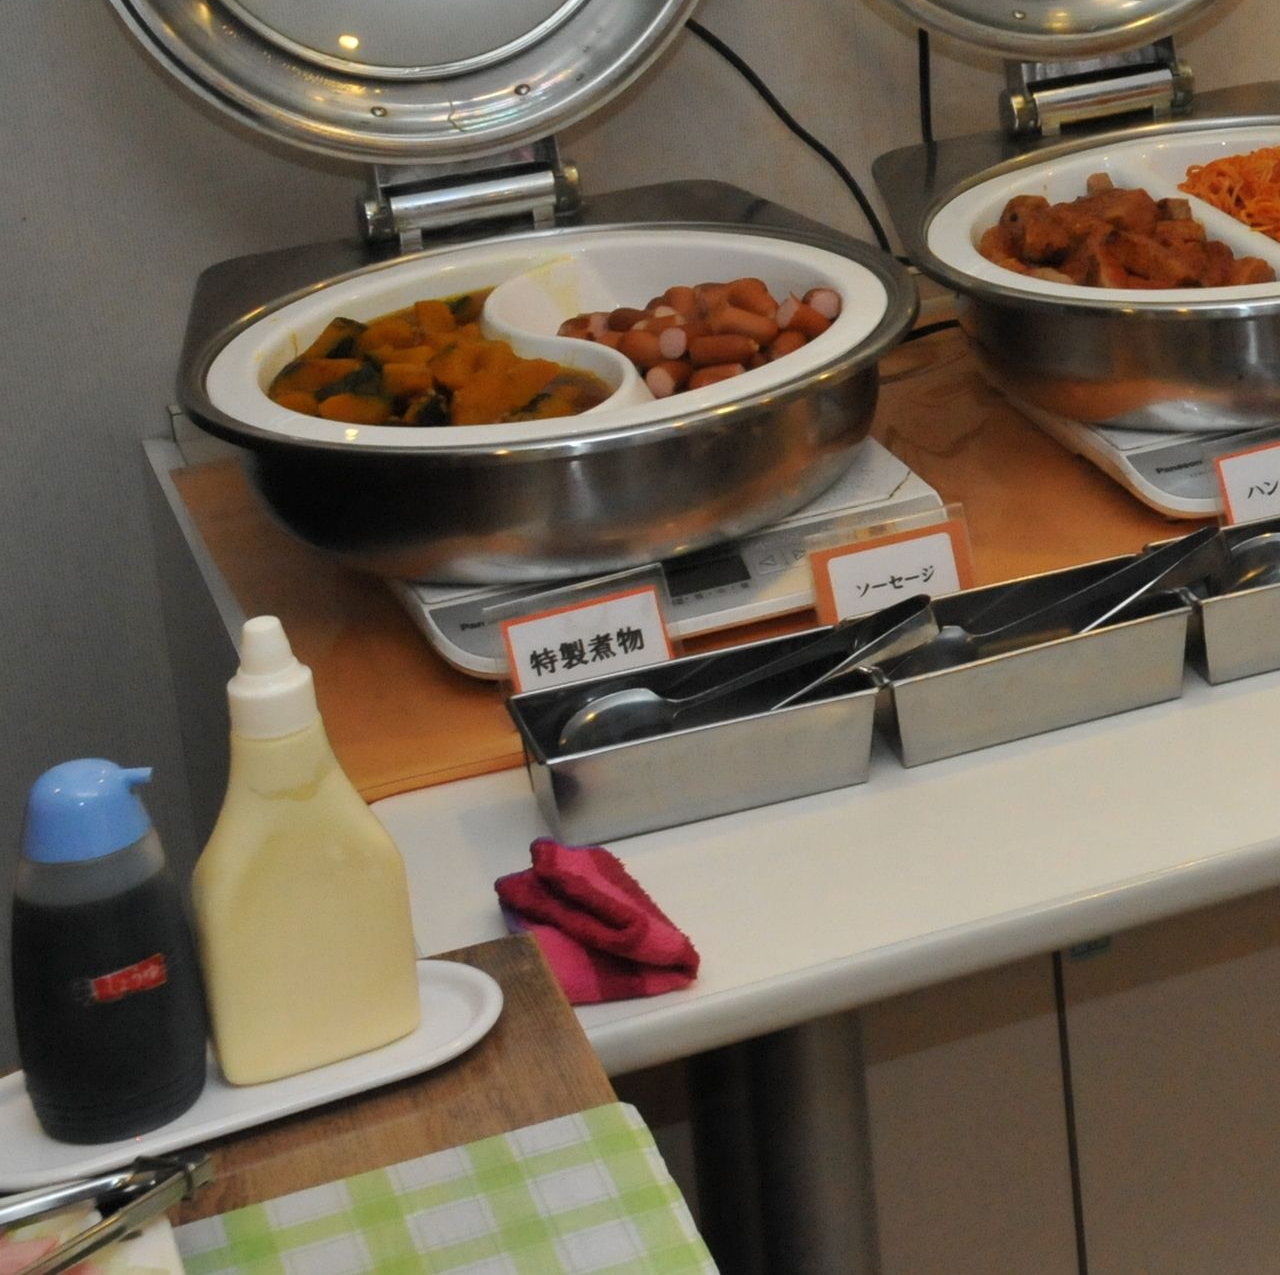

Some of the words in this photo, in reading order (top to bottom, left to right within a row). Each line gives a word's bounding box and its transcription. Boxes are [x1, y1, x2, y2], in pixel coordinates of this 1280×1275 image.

[855, 564, 937, 598] ソーセージ
[528, 626, 646, 678] 特製煮物
